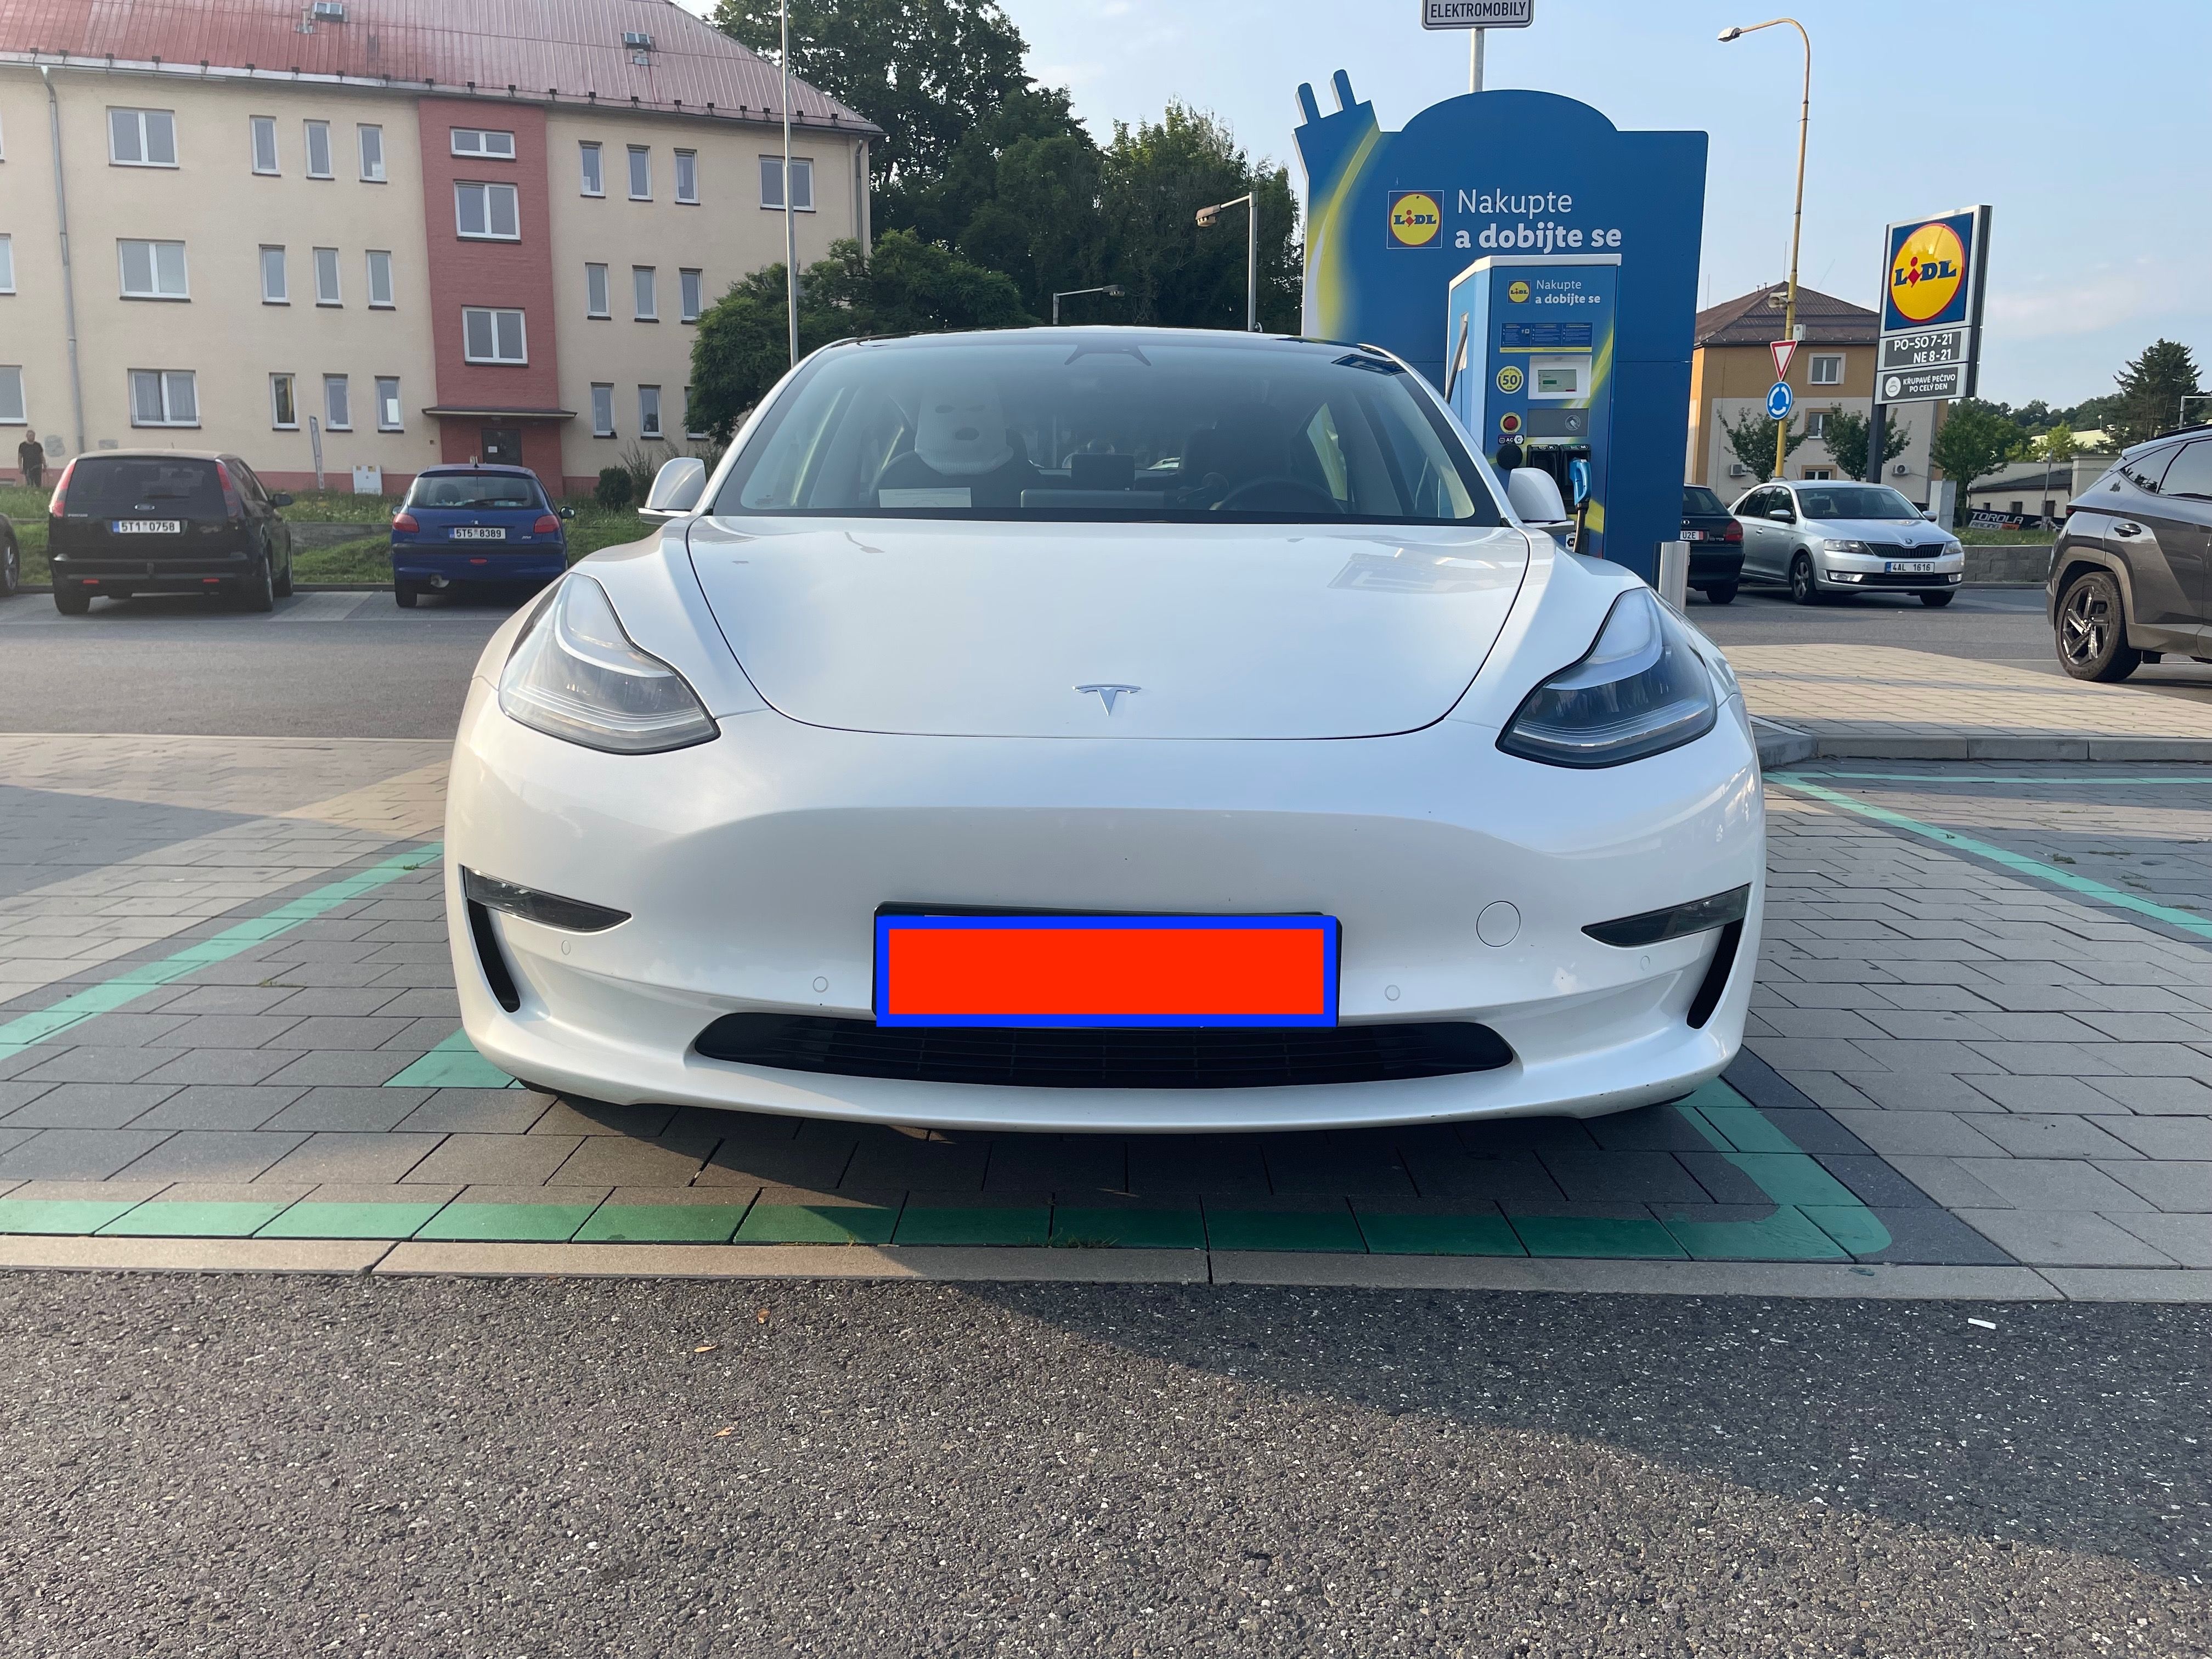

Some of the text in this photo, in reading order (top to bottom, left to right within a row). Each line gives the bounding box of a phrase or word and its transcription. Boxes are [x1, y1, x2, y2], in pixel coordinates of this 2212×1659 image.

[1430, 2, 1526, 18] ELEKTROMOBILY
[1458, 188, 1573, 219] Nakupte
[1455, 222, 1622, 254] a dobijte se
[1537, 279, 1582, 292] Nakupte
[1544, 294, 1585, 306] dobijte
[1588, 295, 1601, 303] se
[1894, 333, 1953, 351] PO-SO 7-21
[1913, 348, 1951, 364] NE 8-21
[1503, 375, 1517, 385] 50
[1903, 373, 1956, 385] KŘUPAVÉ PEČIVO
[1919, 383, 1933, 392] CELÝ
[1934, 382, 1948, 391] DEN
[122, 522, 175, 532] 5T1 0758
[456, 529, 501, 538] 5T5 8389
